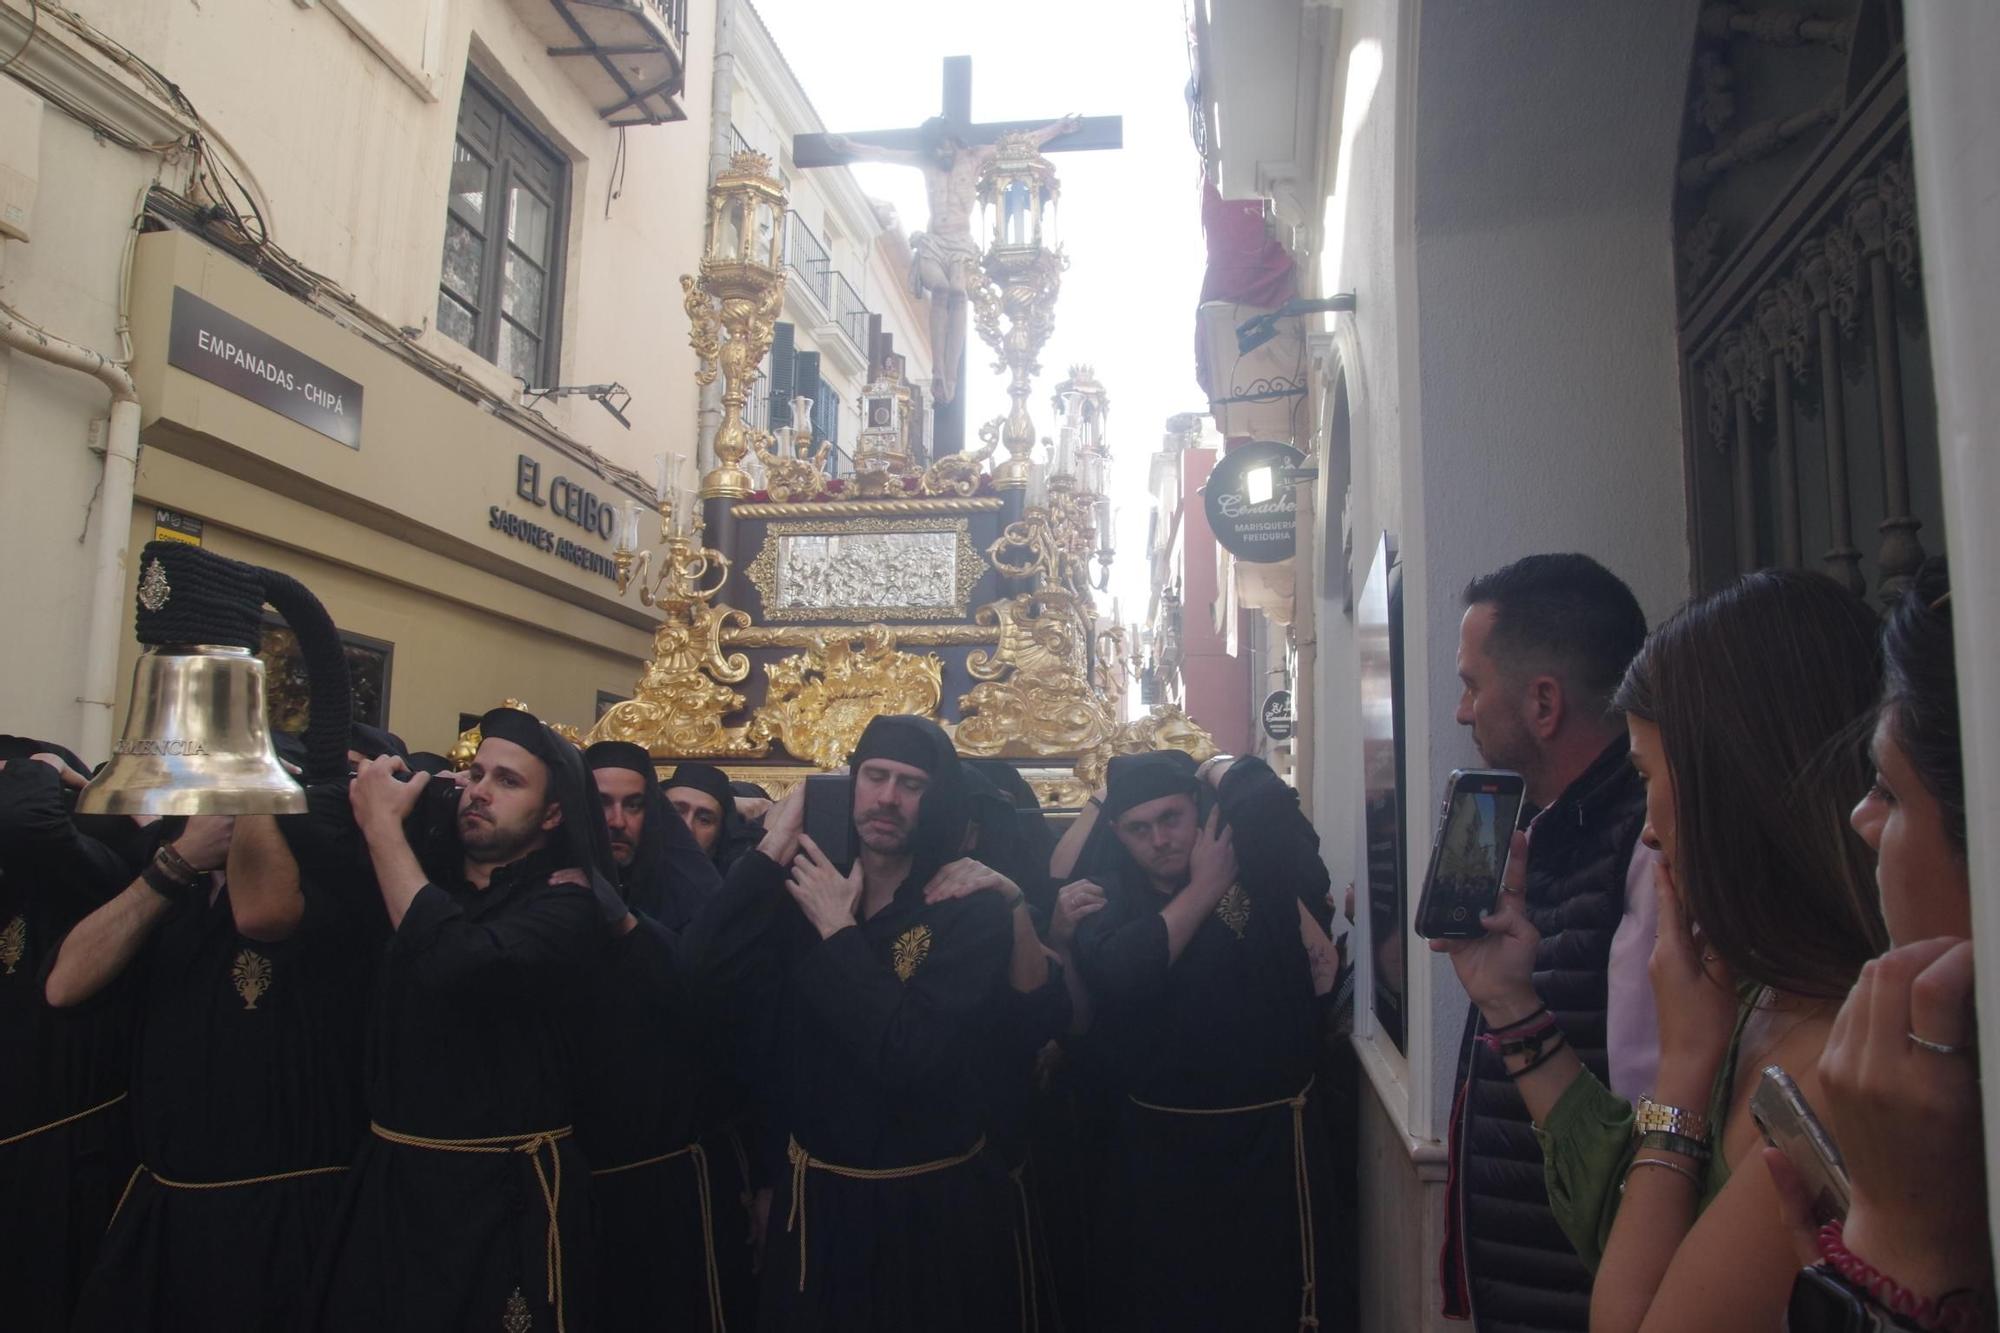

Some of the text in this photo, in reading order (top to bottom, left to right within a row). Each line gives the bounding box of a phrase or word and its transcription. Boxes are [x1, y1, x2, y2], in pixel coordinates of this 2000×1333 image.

[198, 329, 294, 391] EMPANADAS
[304, 383, 344, 416] CHIPÁ
[489, 505, 554, 553] SABORES
[517, 454, 614, 541] EL CEIBO
[1243, 532, 1290, 542] FREIDURIA
